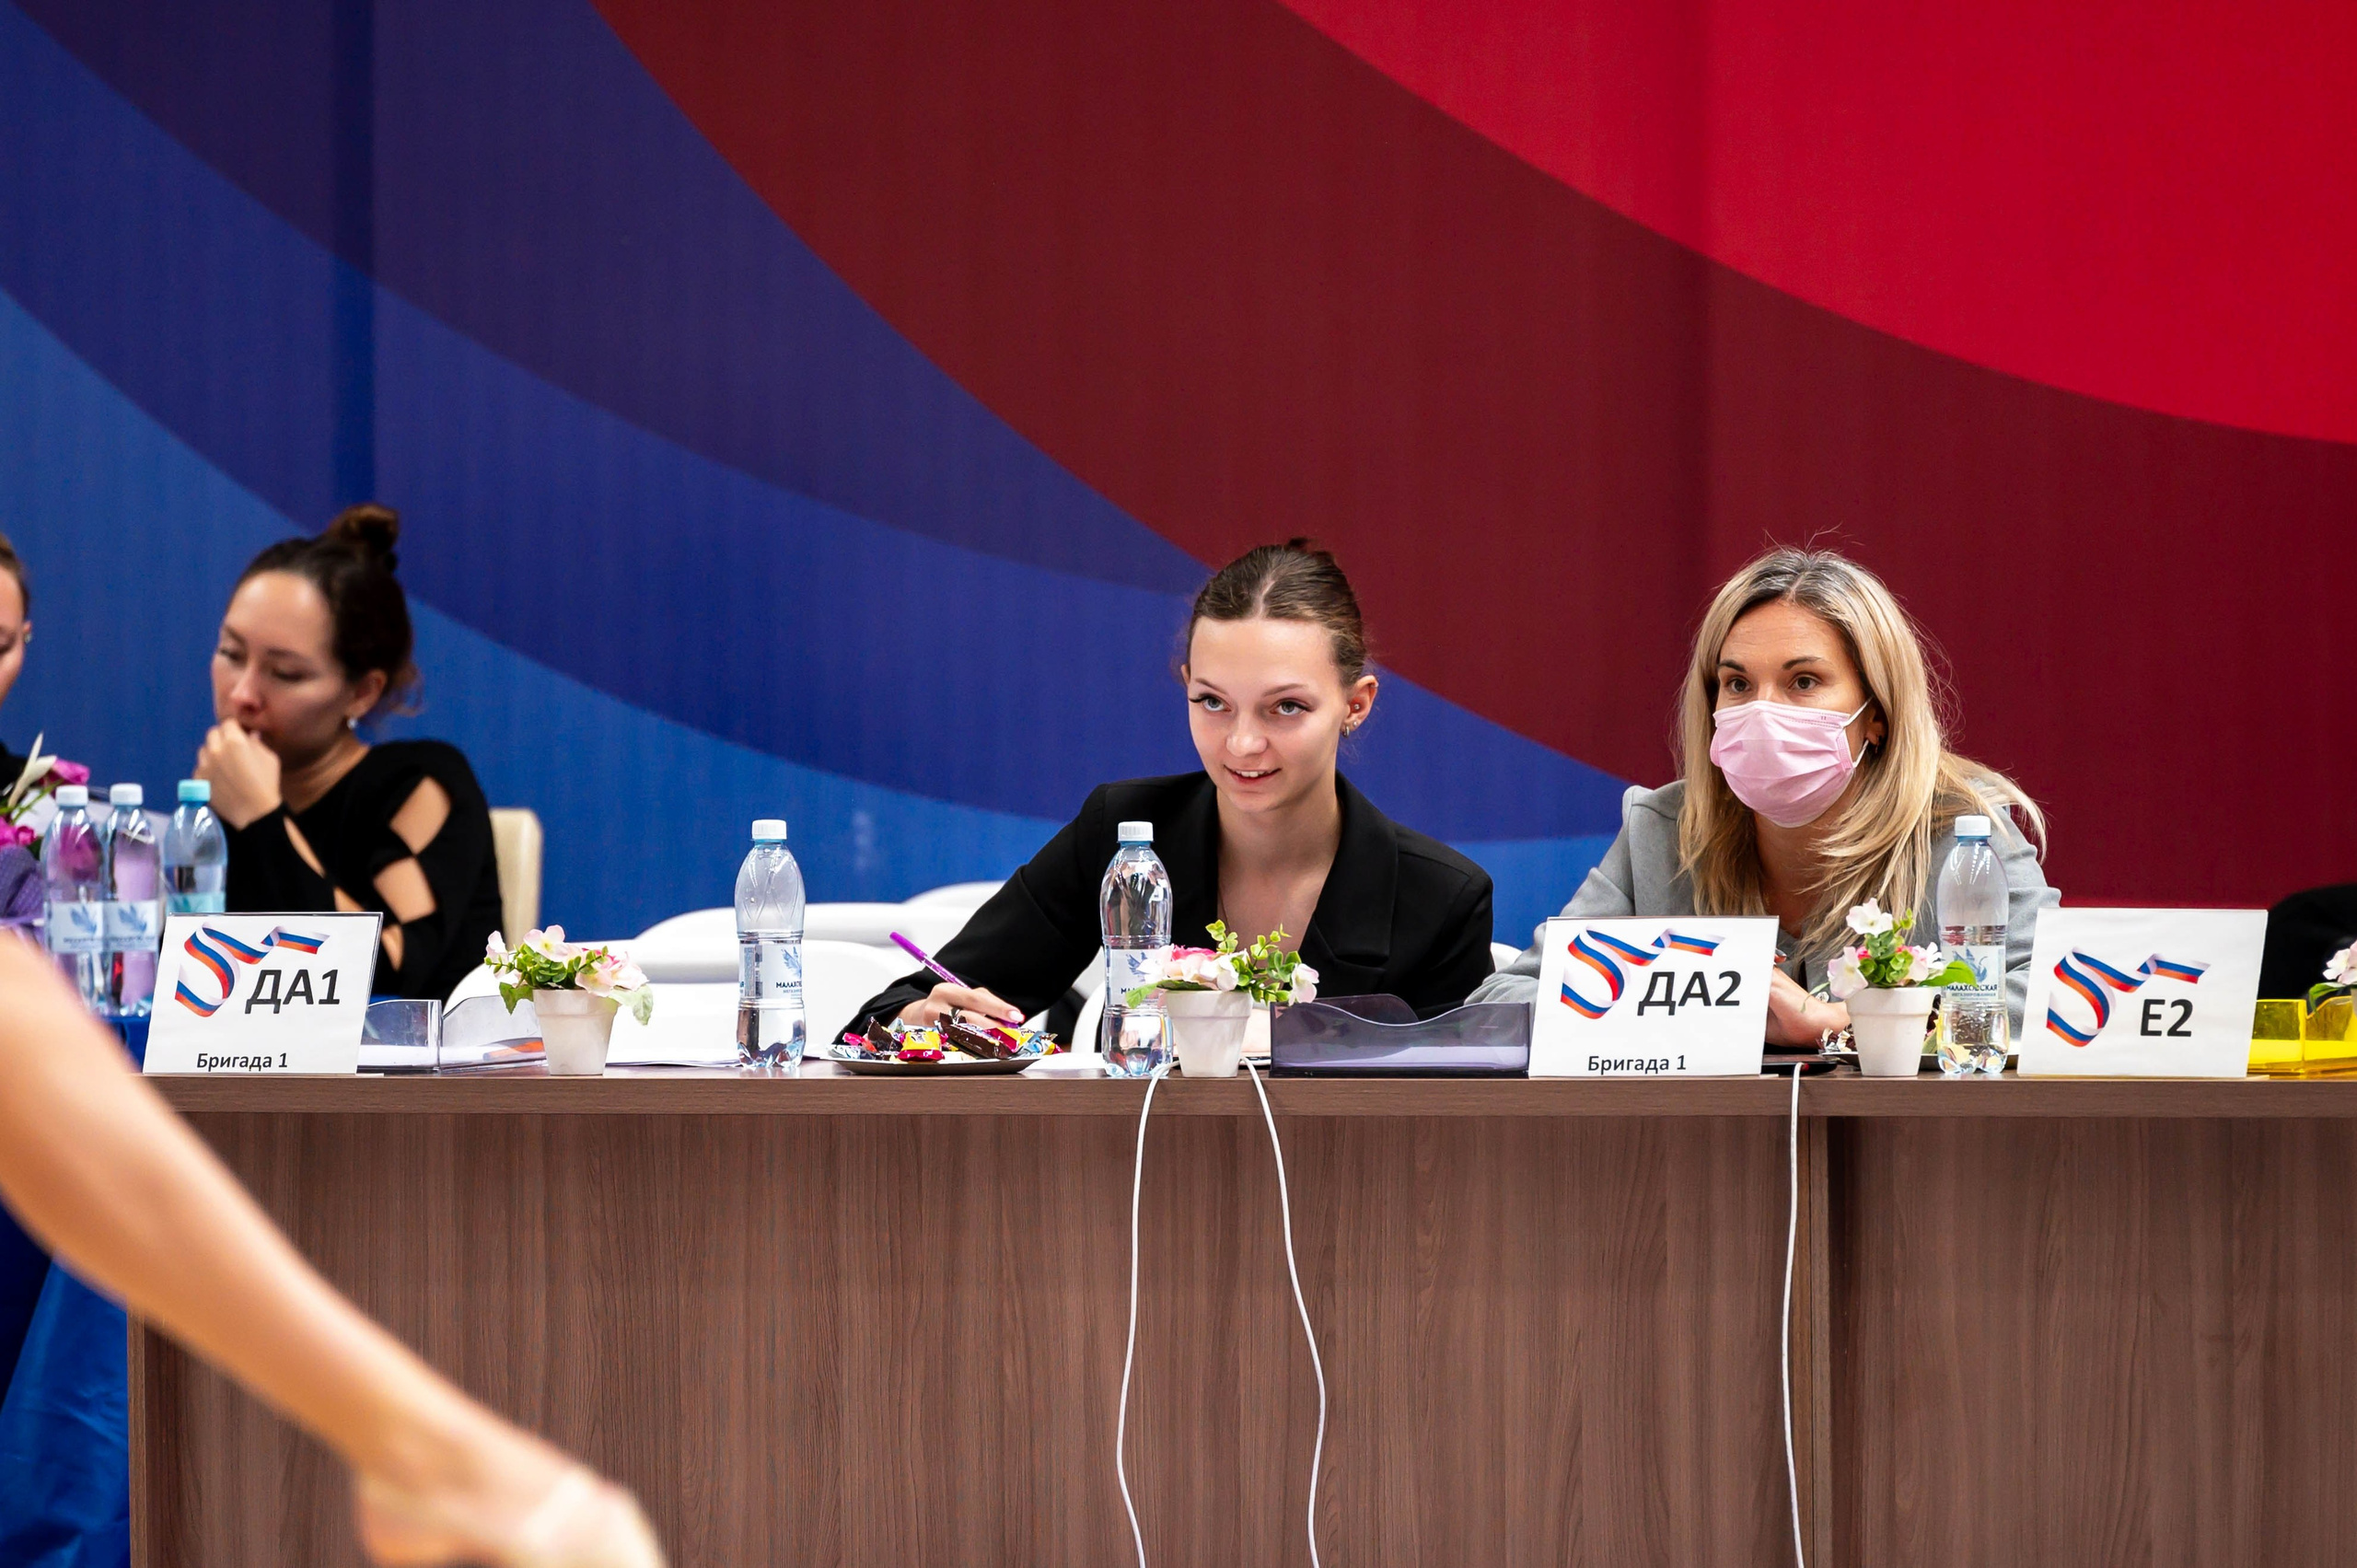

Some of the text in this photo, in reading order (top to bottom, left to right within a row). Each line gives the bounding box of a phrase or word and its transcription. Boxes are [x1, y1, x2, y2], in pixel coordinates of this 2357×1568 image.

[245, 970, 340, 1014] ДА1
[1637, 970, 1741, 1016] ДА2
[2140, 998, 2193, 1037] Е2
[196, 1052, 288, 1072] Бригада 1
[1587, 1054, 1687, 1074] Бригада 1
